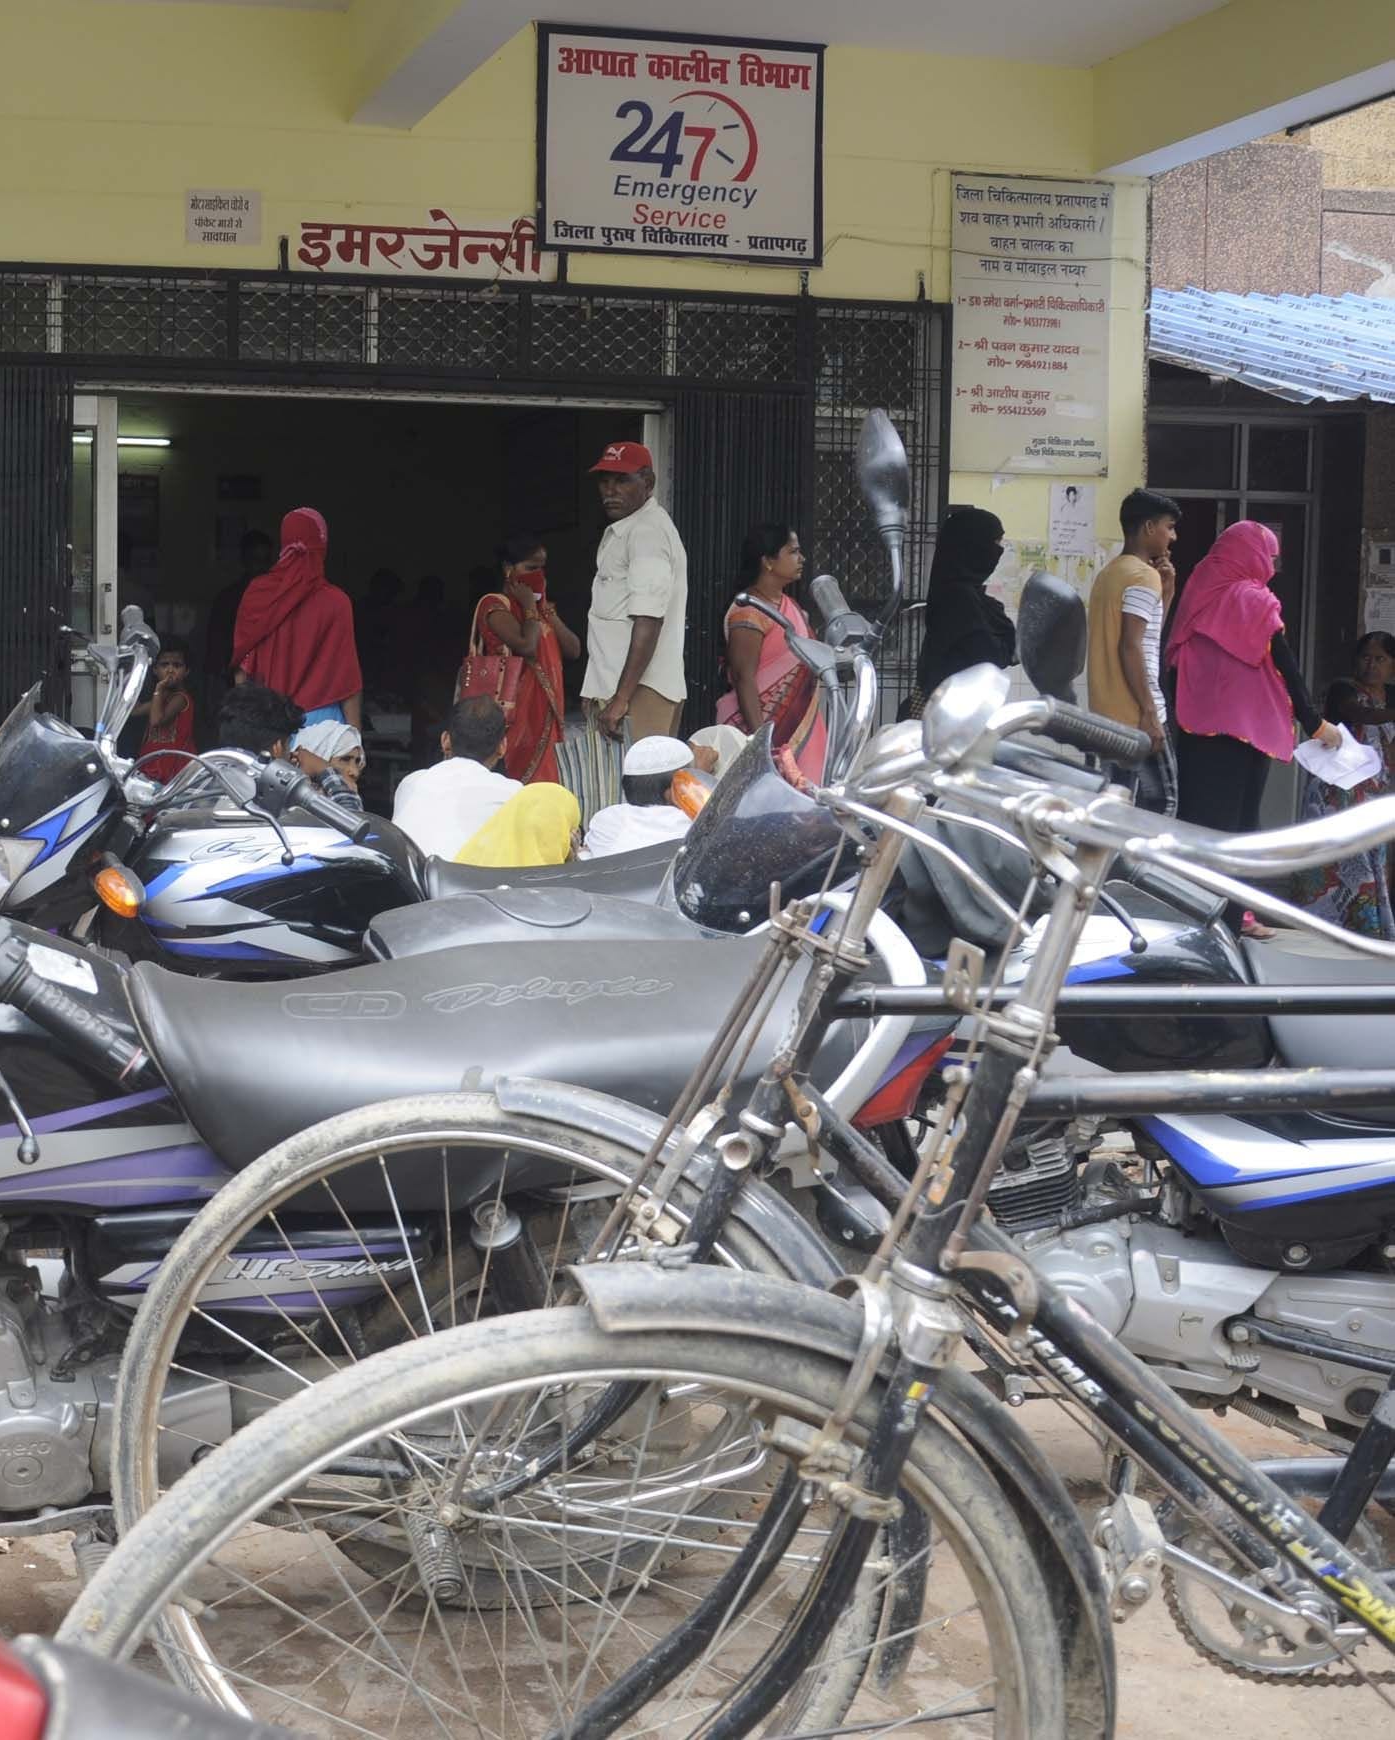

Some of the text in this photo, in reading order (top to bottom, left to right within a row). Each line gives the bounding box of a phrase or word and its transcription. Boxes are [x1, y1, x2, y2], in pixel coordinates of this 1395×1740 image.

[558, 47, 812, 91] आपात कालीन विभाग
[614, 175, 758, 209] Emergency
[633, 204, 727, 230] Service
[982, 213, 1009, 227] वाहन
[298, 208, 541, 275] इमरजेन्सी
[553, 220, 595, 240] जिला
[642, 226, 729, 248] चिकित्सालय
[989, 237, 1016, 250] वाहन
[1058, 240, 1074, 254] का
